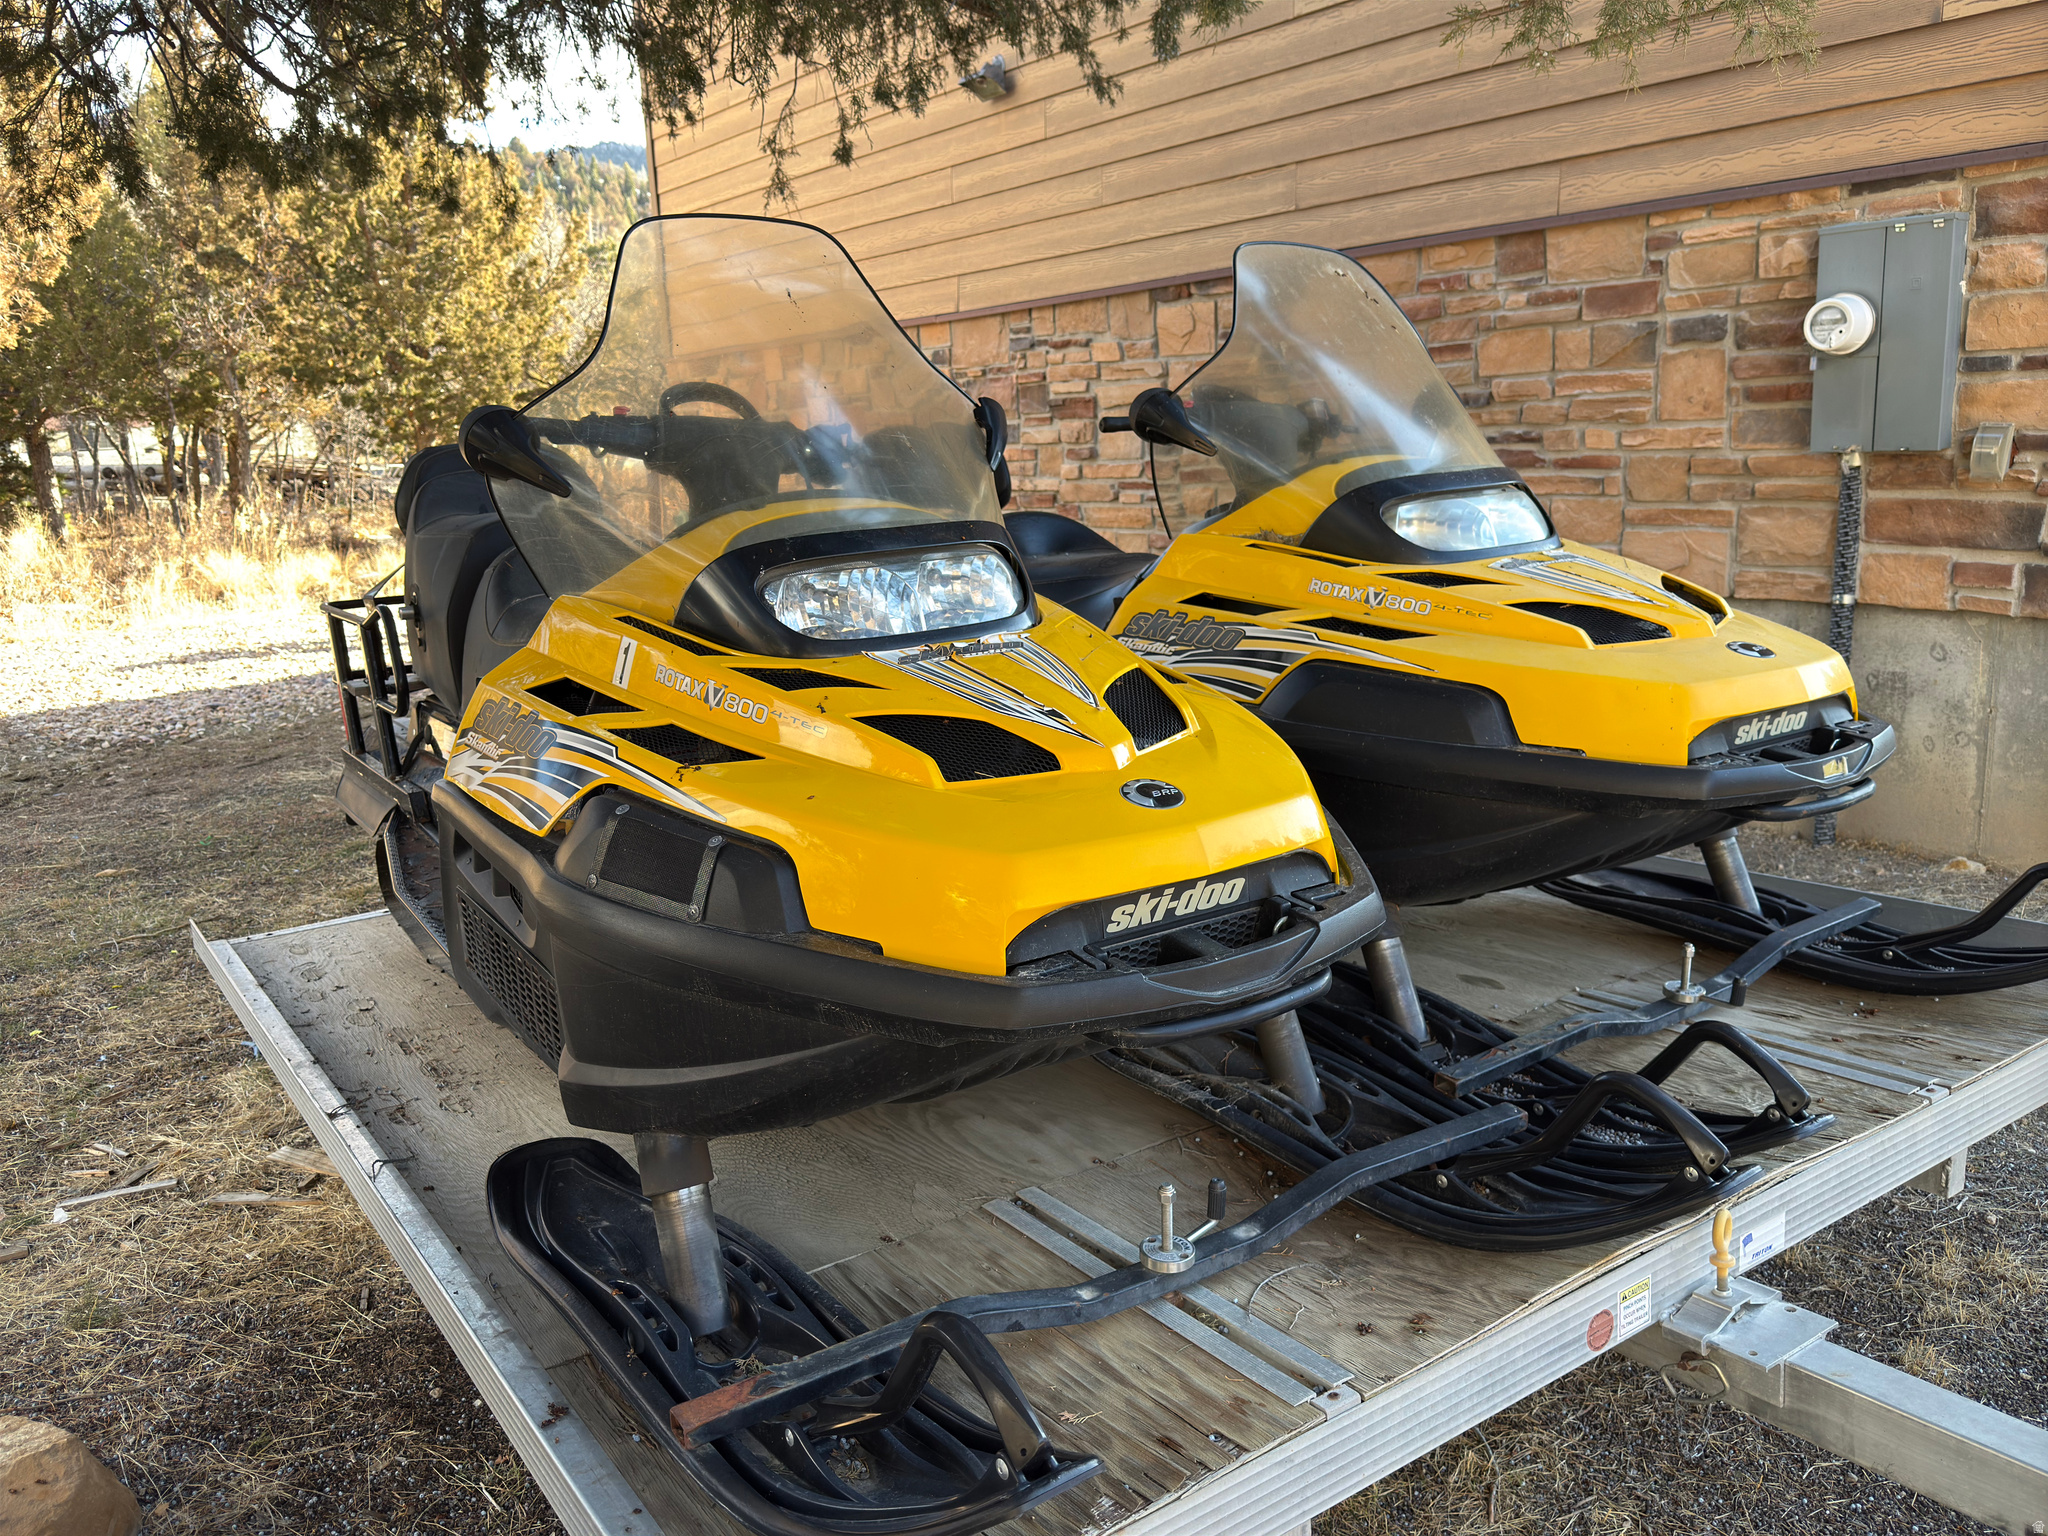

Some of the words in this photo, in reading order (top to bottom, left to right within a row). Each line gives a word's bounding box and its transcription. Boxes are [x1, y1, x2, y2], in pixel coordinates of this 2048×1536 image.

[1308, 578, 1365, 602] ROTAX
[1385, 595, 1431, 616] 800
[1124, 609, 1247, 651] ski-doo
[619, 642, 631, 685] 1
[654, 664, 704, 700] ROTAX
[723, 692, 769, 724] 800
[473, 697, 557, 760] ski-doo
[1734, 710, 1808, 745] ski-doo
[1152, 788, 1178, 798] BRP
[1106, 877, 1246, 933] ski-doo
[1627, 1281, 1649, 1298] CAUTION
